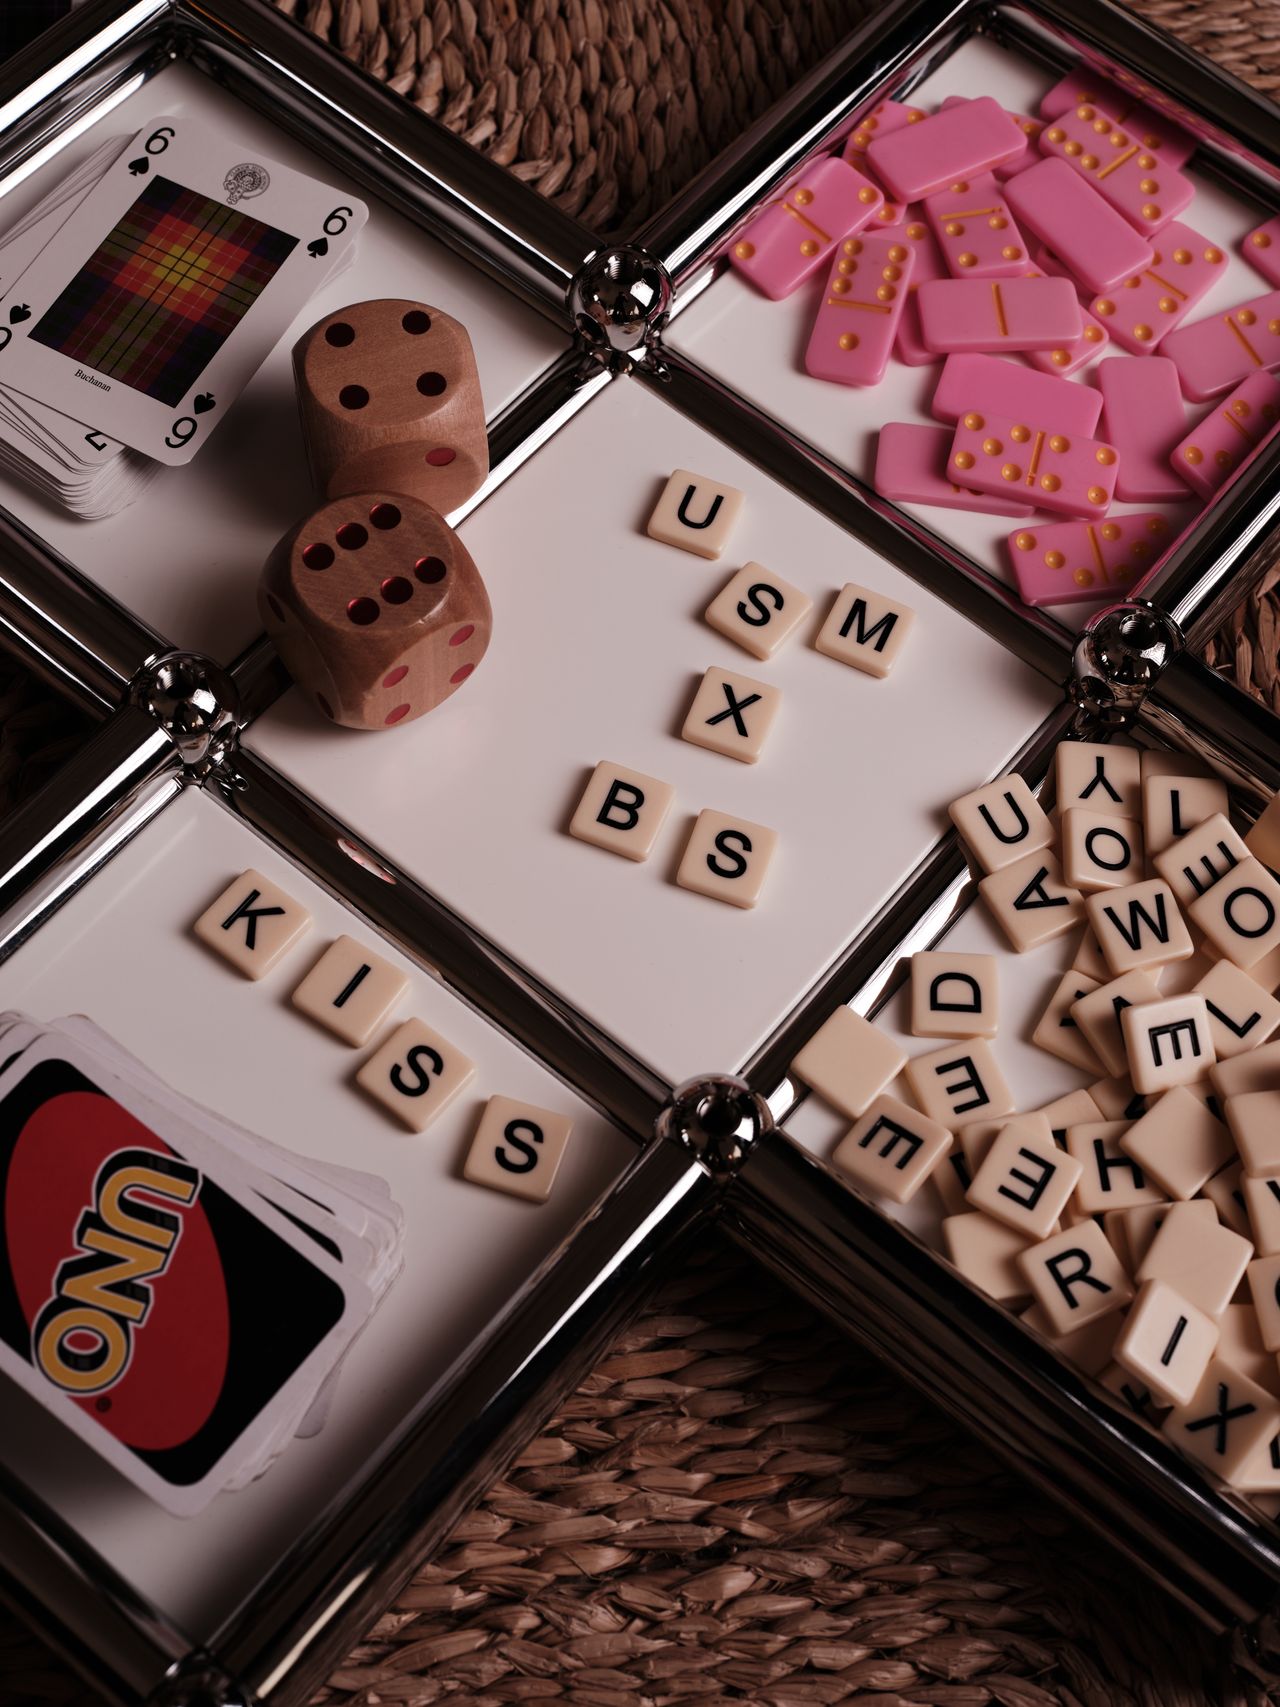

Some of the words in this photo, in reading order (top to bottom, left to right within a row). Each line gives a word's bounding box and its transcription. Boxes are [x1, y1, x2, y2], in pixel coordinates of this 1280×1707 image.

[144, 127, 176, 155] 6
[322, 206, 353, 236] 6
[74, 368, 112, 393] Buchanan
[1078, 755, 1124, 804] Y
[977, 791, 1030, 845] U
[1085, 827, 1132, 872] O
[1012, 866, 1071, 911] A
[1223, 886, 1276, 939] O
[1103, 892, 1170, 951] W
[929, 971, 982, 1014] D
[1148, 1018, 1201, 1067] E
[935, 1055, 990, 1115] E
[857, 1114, 925, 1171] E
[997, 1147, 1057, 1211] E
[32, 1147, 202, 1397] UNO
[1044, 1247, 1113, 1310] R
[1184, 1381, 1258, 1456] X
